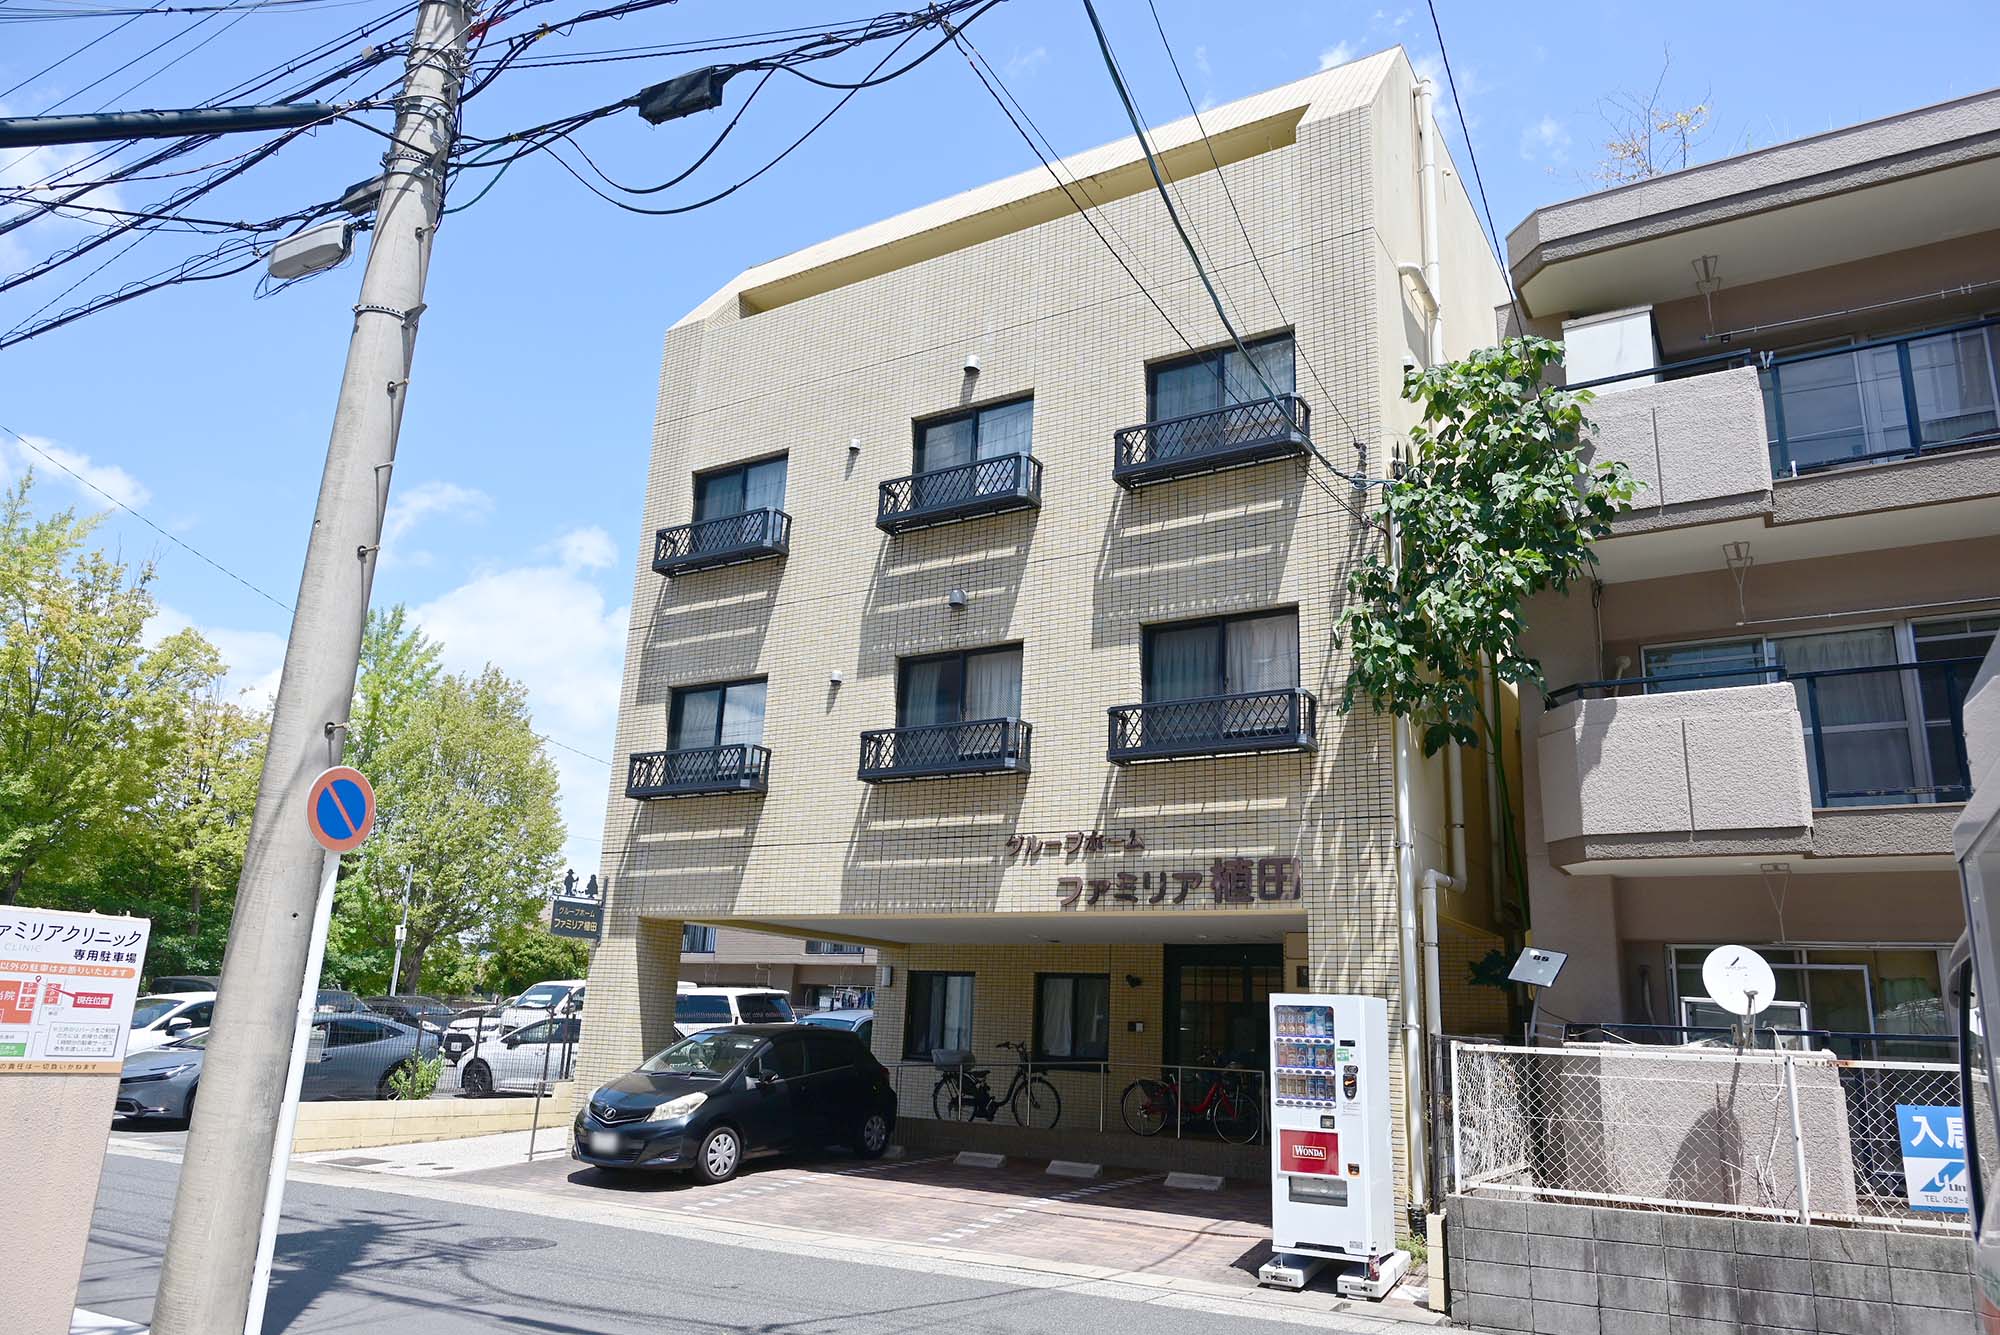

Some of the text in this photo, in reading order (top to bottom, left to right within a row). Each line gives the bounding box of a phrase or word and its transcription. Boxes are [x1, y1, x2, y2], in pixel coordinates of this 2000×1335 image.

[1006, 830, 1145, 857] グループホーム
[1057, 857, 1301, 906] ファミリア植田
[73, 949, 137, 963] 専用駐車場
[1295, 1145, 1324, 1157] WONDA
[1924, 1194, 1940, 1203] TEL
